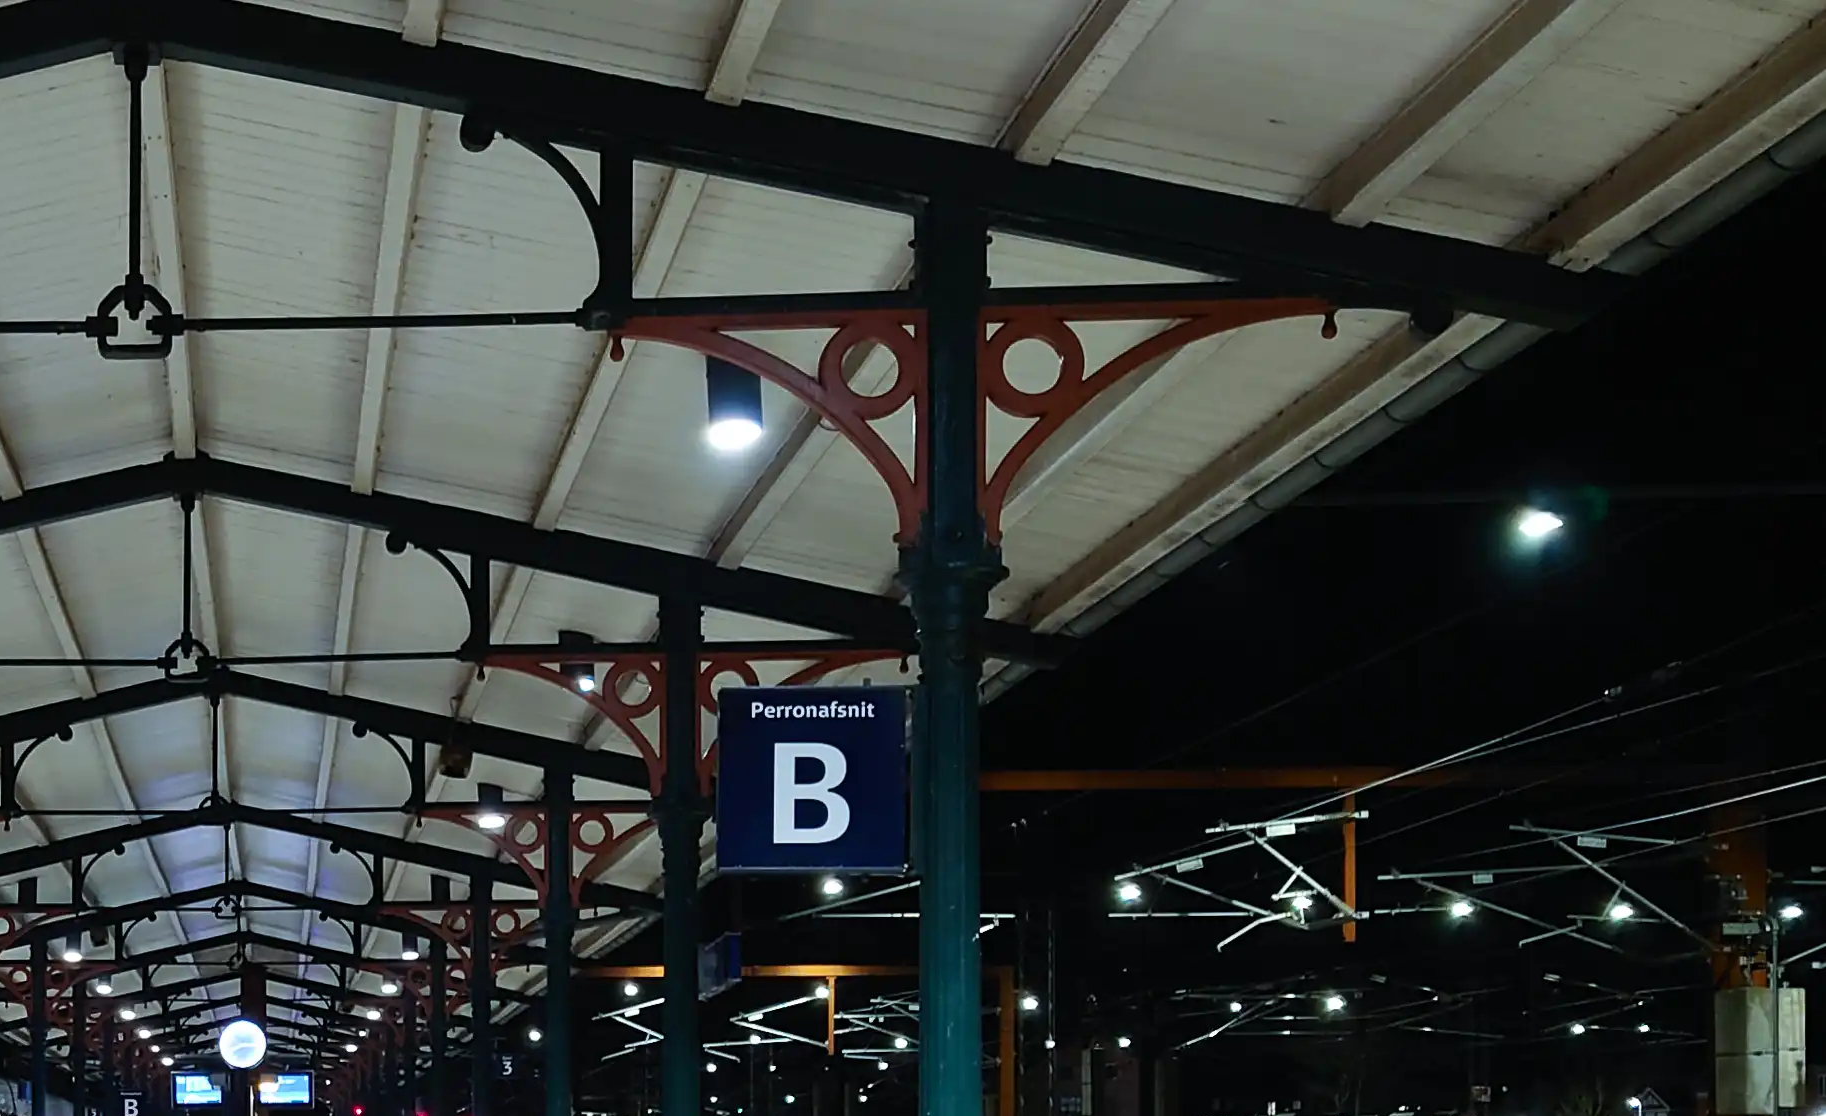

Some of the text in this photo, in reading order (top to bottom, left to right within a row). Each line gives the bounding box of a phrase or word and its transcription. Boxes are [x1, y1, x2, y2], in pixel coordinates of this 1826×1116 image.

[751, 700, 875, 719] Perronafsnit
[773, 742, 851, 844] B
[502, 1061, 513, 1076] 3
